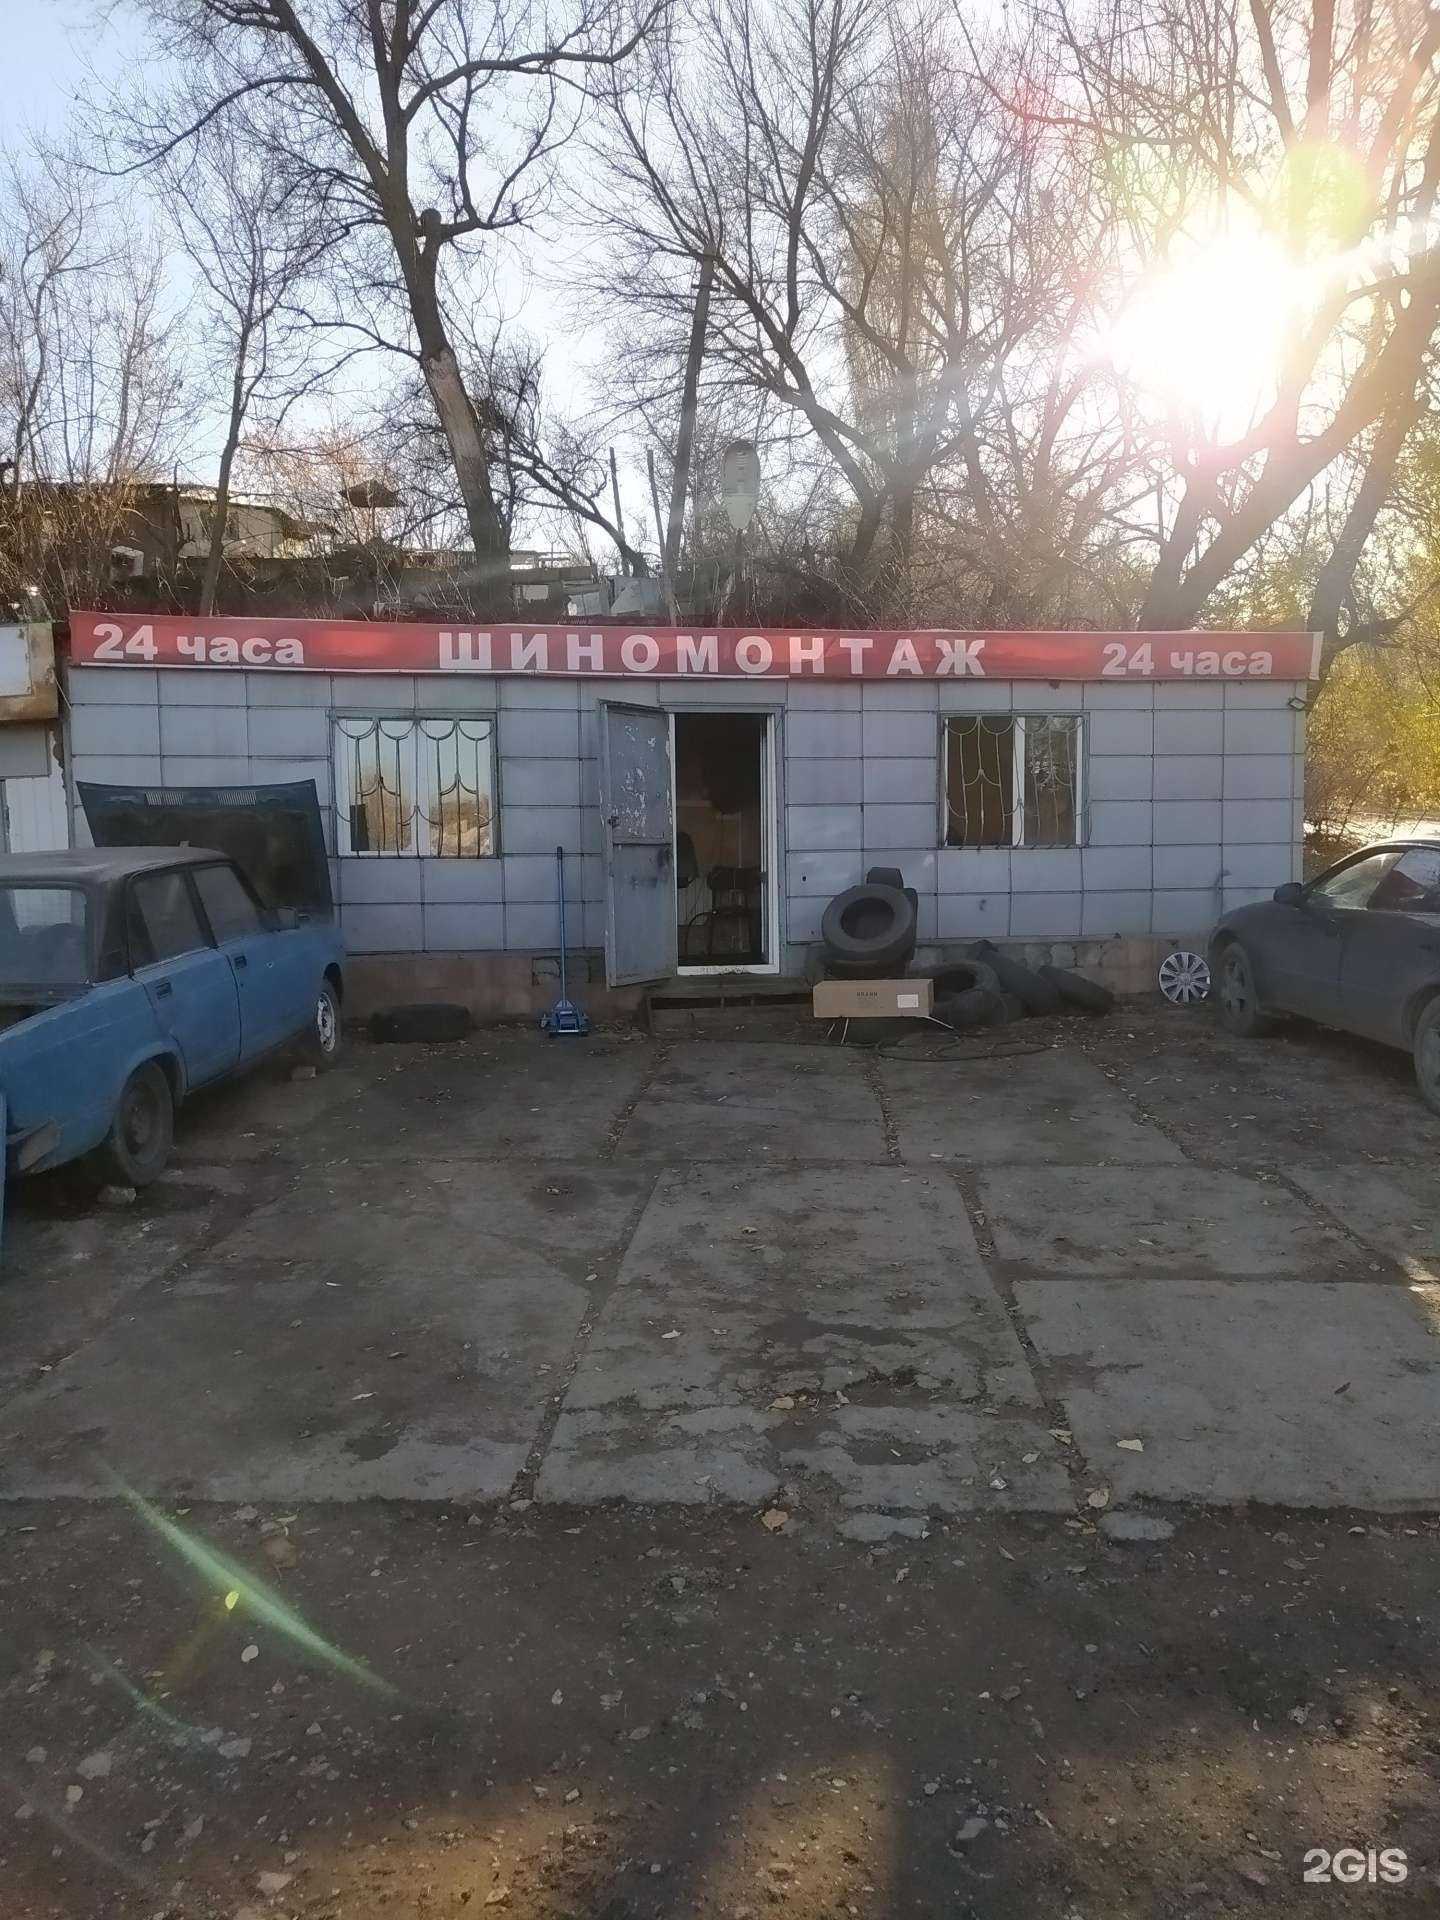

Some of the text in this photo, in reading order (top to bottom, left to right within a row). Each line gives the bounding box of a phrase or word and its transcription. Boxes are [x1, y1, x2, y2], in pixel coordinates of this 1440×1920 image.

[92, 623, 304, 664] 24 часа
[438, 631, 986, 677] ШИНОМОНТАЖ
[1102, 642, 1273, 676] 24 часа
